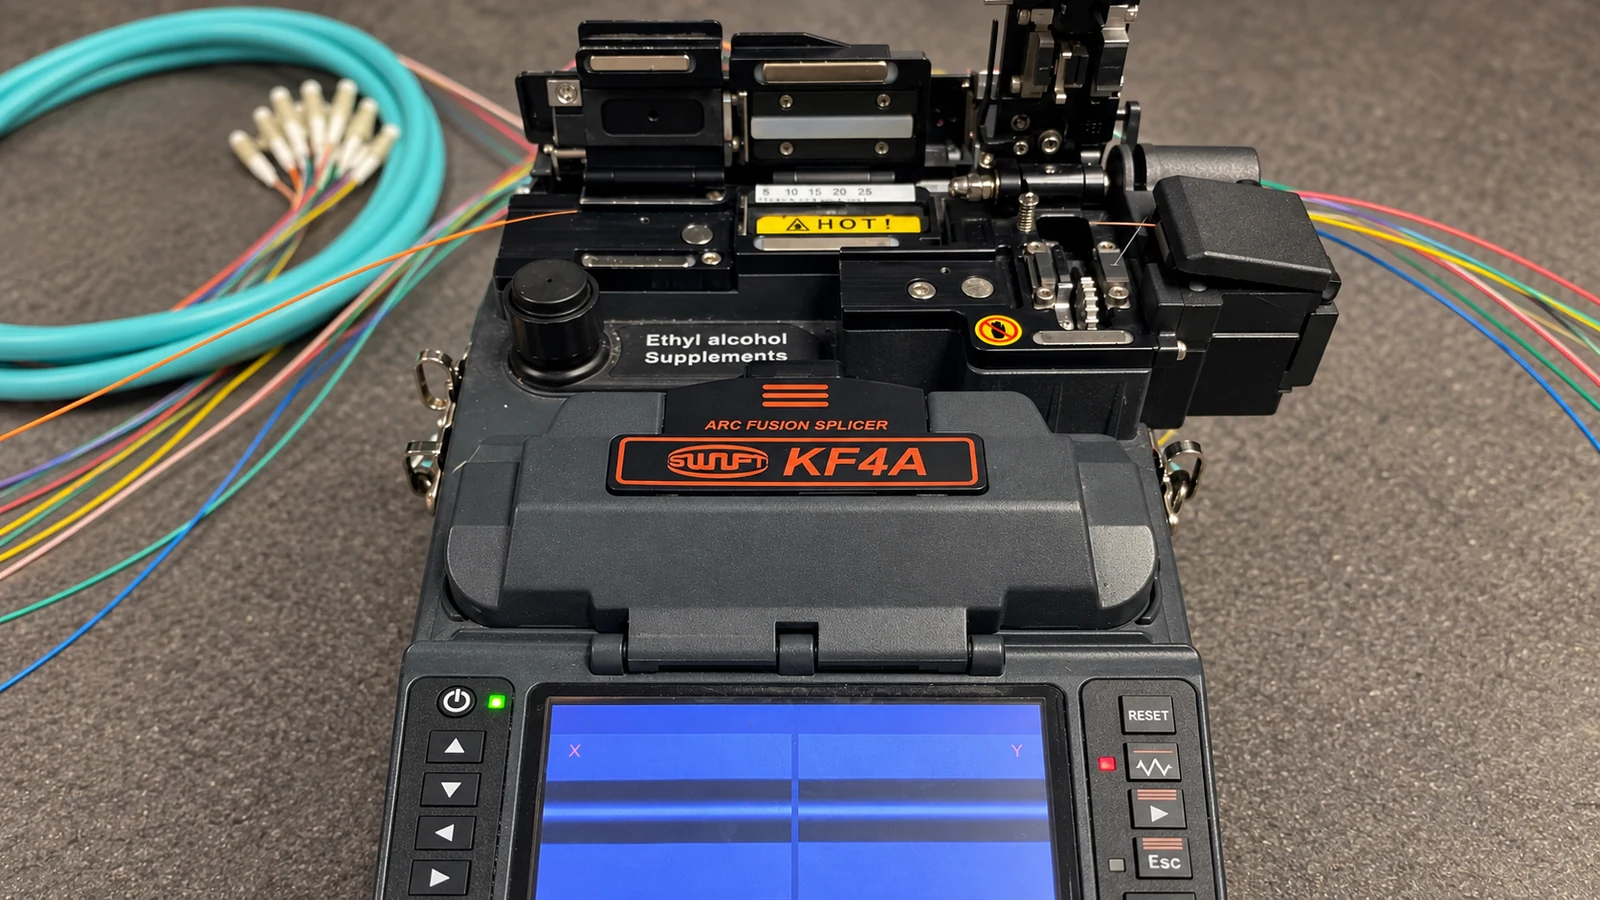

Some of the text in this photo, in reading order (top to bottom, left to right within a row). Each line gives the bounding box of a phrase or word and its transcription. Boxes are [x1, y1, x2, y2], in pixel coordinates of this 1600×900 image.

[763, 188, 872, 196] 5 10 15 20 25
[646, 333, 787, 348] Ethyl alcohol
[644, 350, 788, 365] Supplements
[704, 420, 888, 431] ARC FUSION SPLICER
[783, 447, 927, 476] KF4A
[1128, 710, 1169, 721] RESET
[568, 744, 581, 757] X
[1011, 744, 1022, 757] Y
[1148, 854, 1181, 869] Esc
